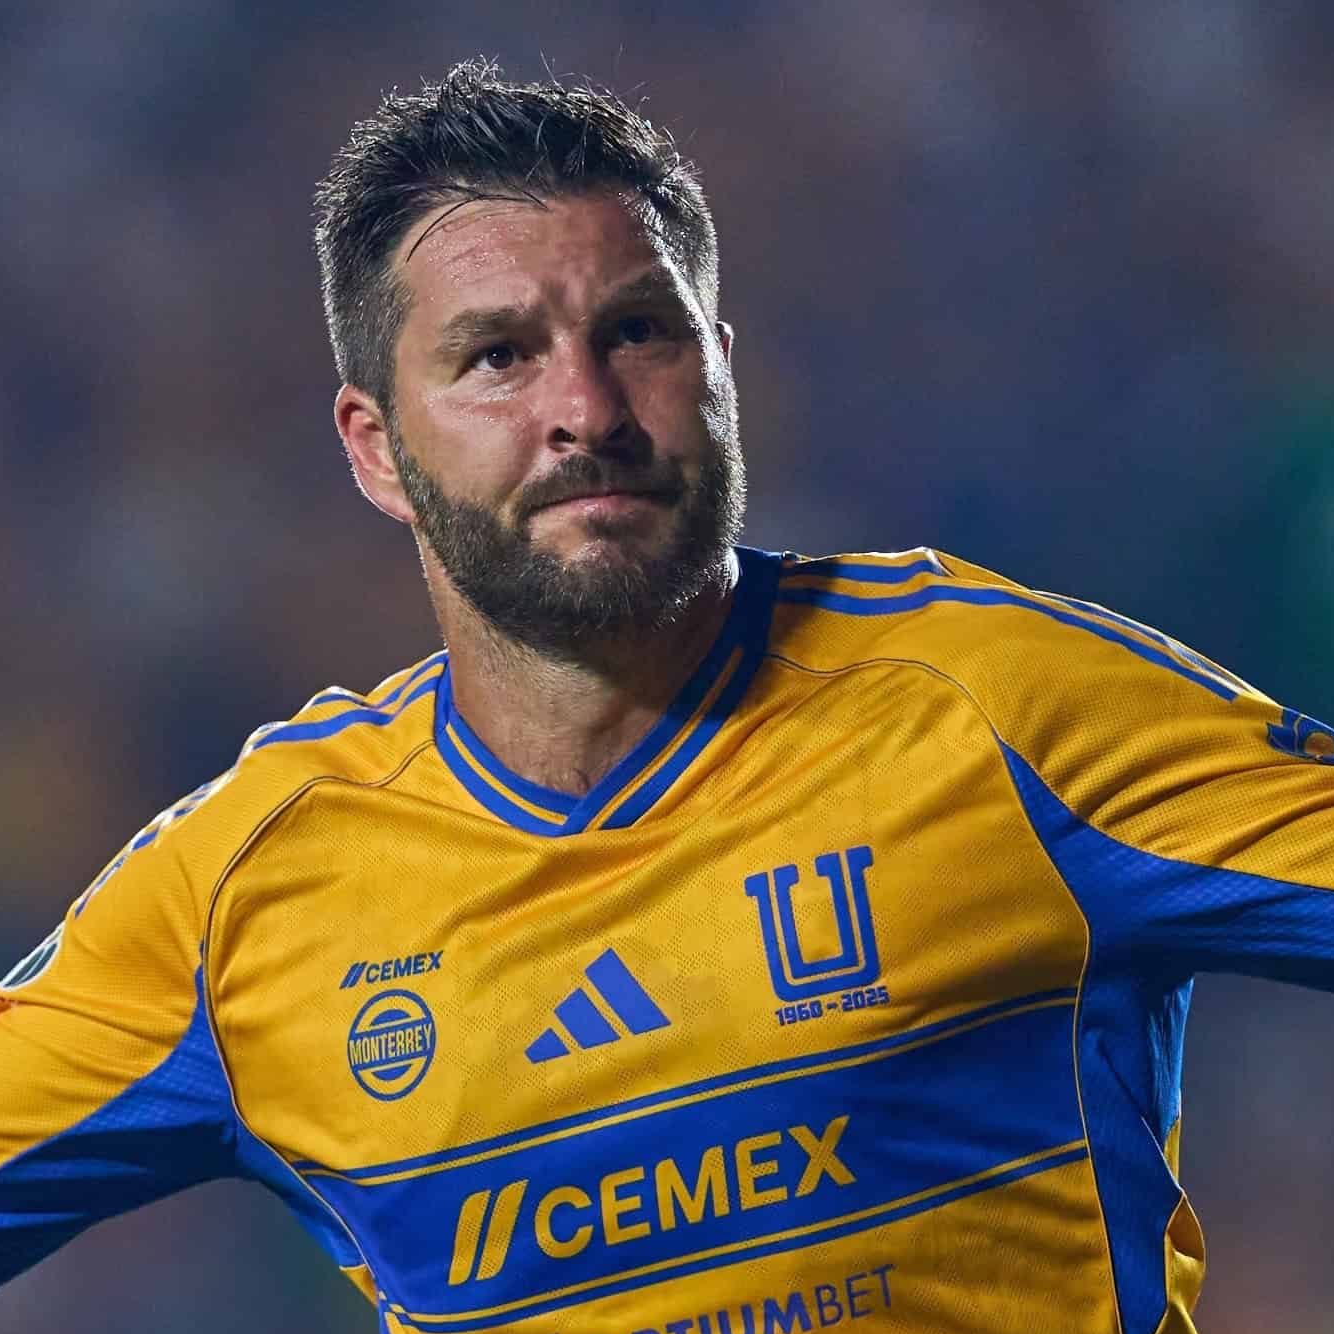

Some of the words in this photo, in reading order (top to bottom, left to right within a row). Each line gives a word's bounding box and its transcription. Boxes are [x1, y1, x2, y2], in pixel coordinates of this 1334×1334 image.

[365, 950, 444, 984] CEMEX
[744, 845, 881, 1003] U
[349, 1023, 433, 1065] MONTERREY
[534, 1113, 857, 1260] CEMEX
